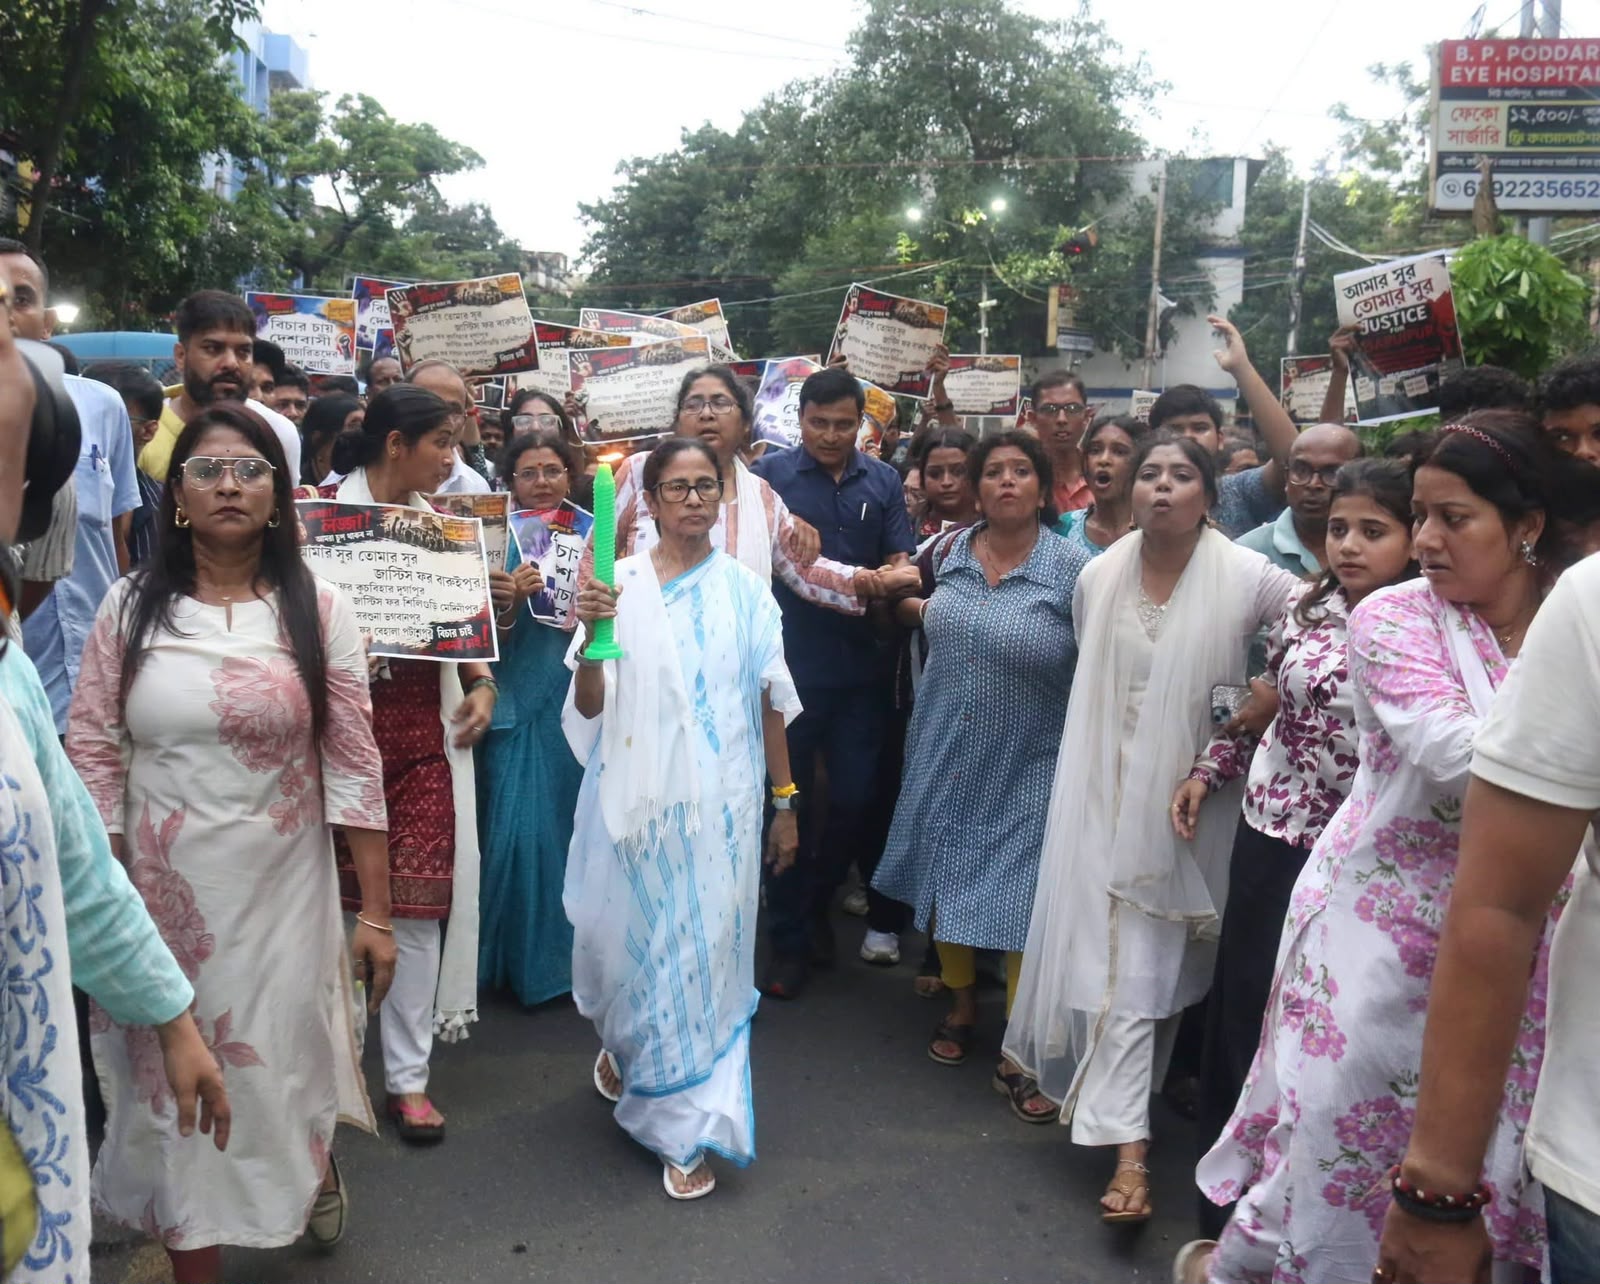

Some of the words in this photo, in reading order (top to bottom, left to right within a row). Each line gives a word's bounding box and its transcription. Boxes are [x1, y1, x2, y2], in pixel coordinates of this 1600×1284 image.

[1456, 45, 1474, 62] B.
[1481, 45, 1500, 62] P.
[1507, 44, 1600, 61] PODDAR
[1450, 65, 1490, 83] EYE
[1463, 180, 1600, 198] 692235652
[1342, 272, 1389, 299] আমার
[1391, 263, 1417, 287] সুর
[1353, 287, 1406, 318] তোমার
[1410, 277, 1435, 300] সুর
[270, 315, 306, 332] বিচার
[1360, 305, 1428, 335] JUSTICE
[335, 548, 353, 564] সুর
[358, 550, 398, 563] তোমার
[401, 553, 418, 567] সুর
[373, 564, 413, 582] জাস্টিস
[416, 571, 433, 583] ফর
[435, 574, 481, 592] বারুইপুর
[436, 625, 457, 639] বিচার
[458, 624, 474, 637] চাই
